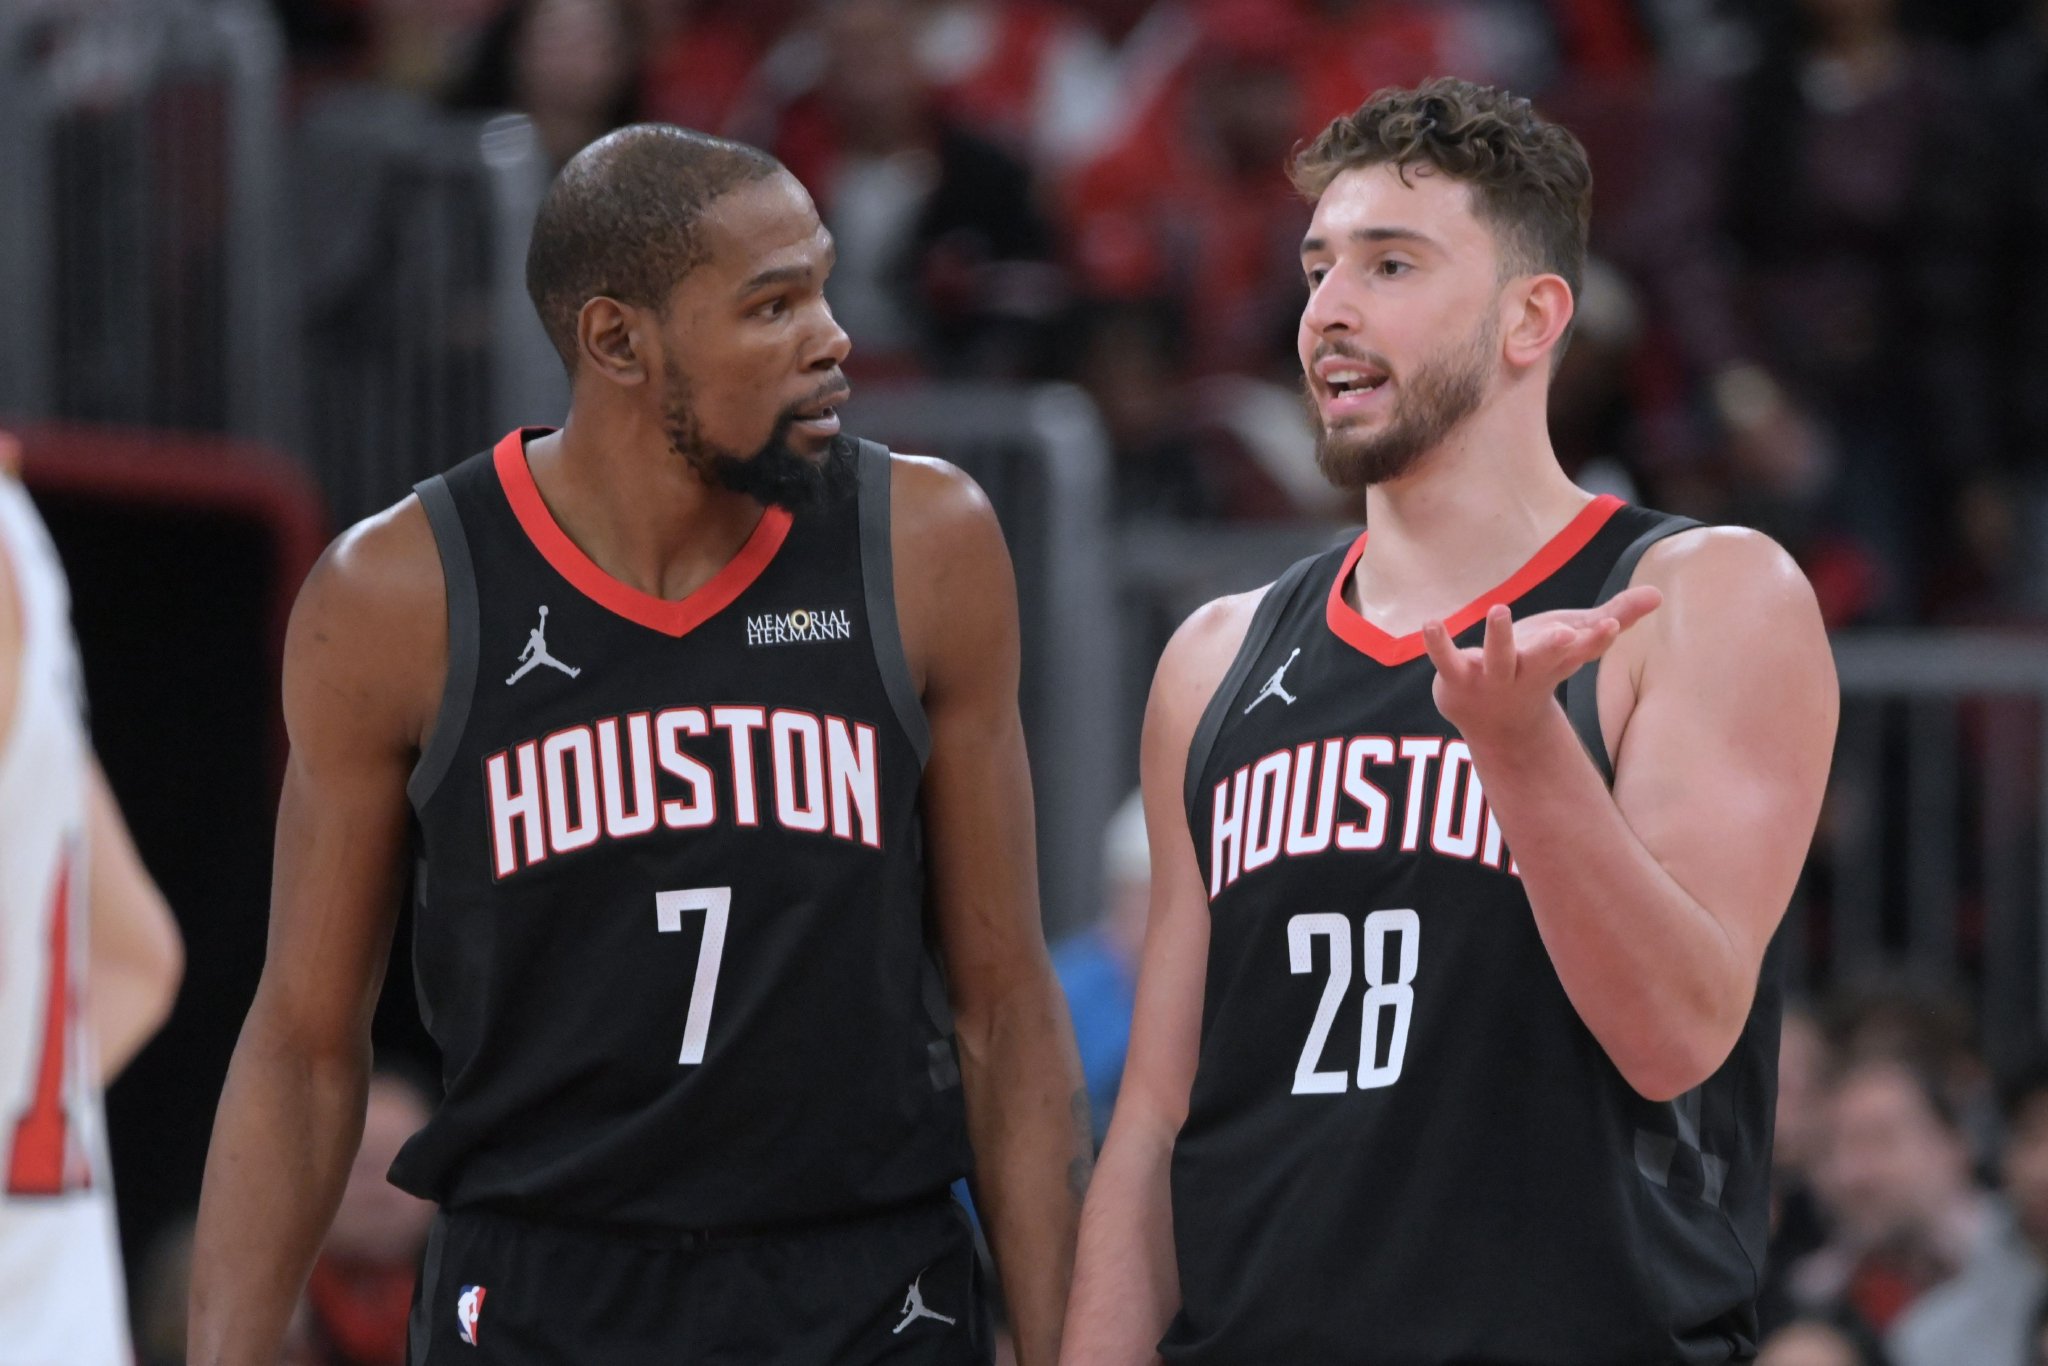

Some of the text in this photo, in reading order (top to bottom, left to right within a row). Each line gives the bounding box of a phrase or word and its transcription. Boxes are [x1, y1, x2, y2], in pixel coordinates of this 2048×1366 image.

[747, 609, 850, 632] MEMORIAL
[748, 623, 850, 645] HERMANN
[486, 704, 881, 879] HOUSTON
[655, 886, 732, 1065] 7
[1286, 908, 1421, 1096] 28
